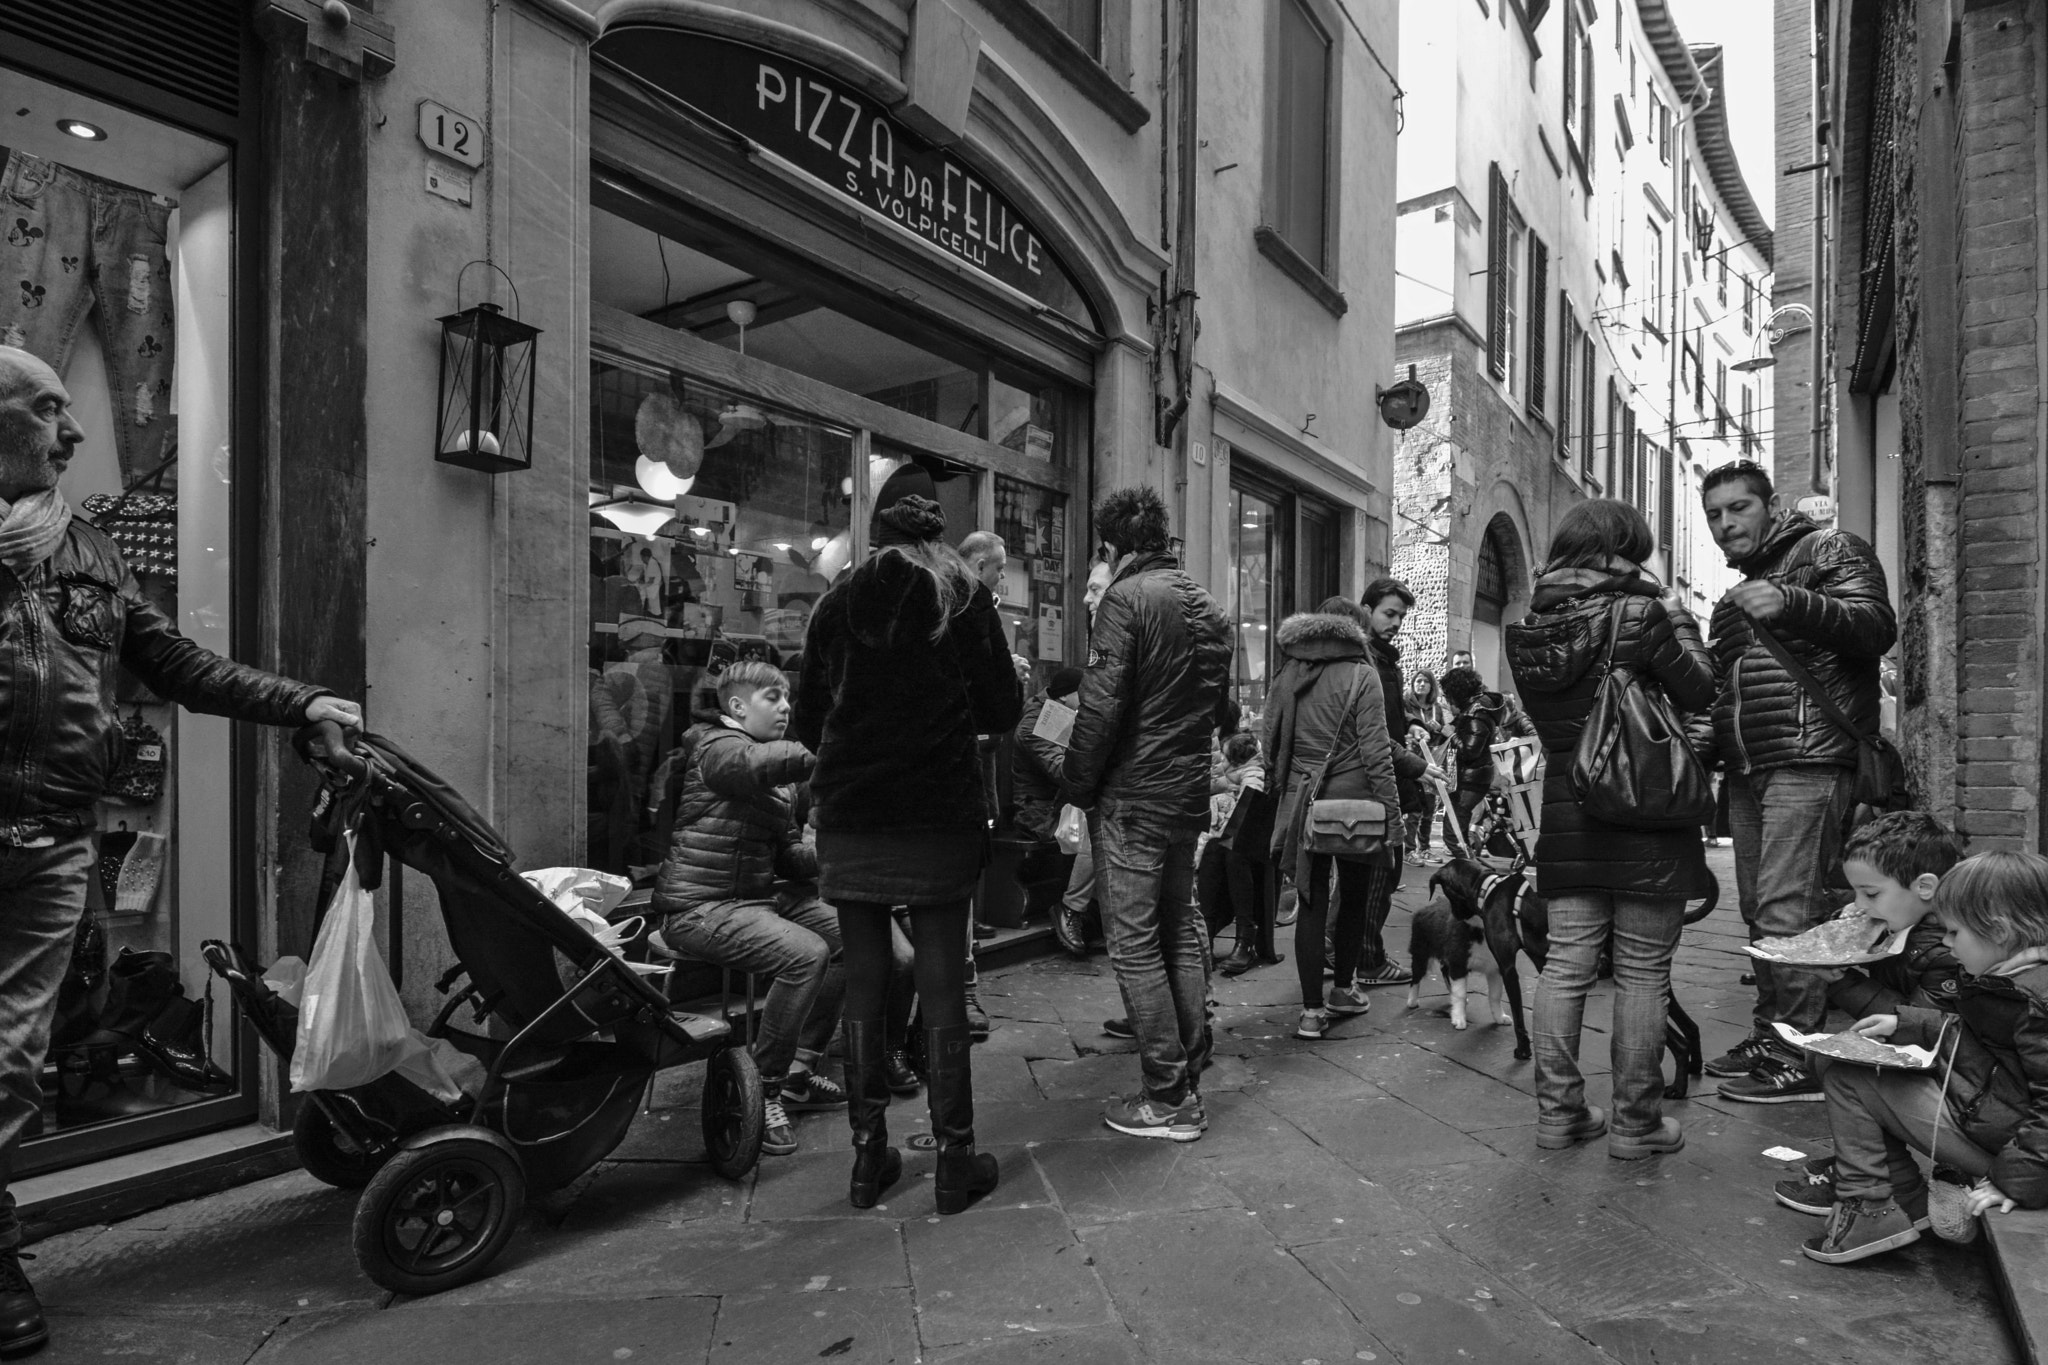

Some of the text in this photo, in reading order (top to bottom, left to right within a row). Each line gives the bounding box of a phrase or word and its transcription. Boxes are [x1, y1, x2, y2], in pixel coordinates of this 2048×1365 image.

[436, 114, 469, 156] 12
[756, 63, 1042, 276] PIZZA DA FELICE
[846, 170, 986, 267] S. VOLPICELLI
[1195, 445, 1203, 461] 10
[1044, 558, 1061, 573] DAY
